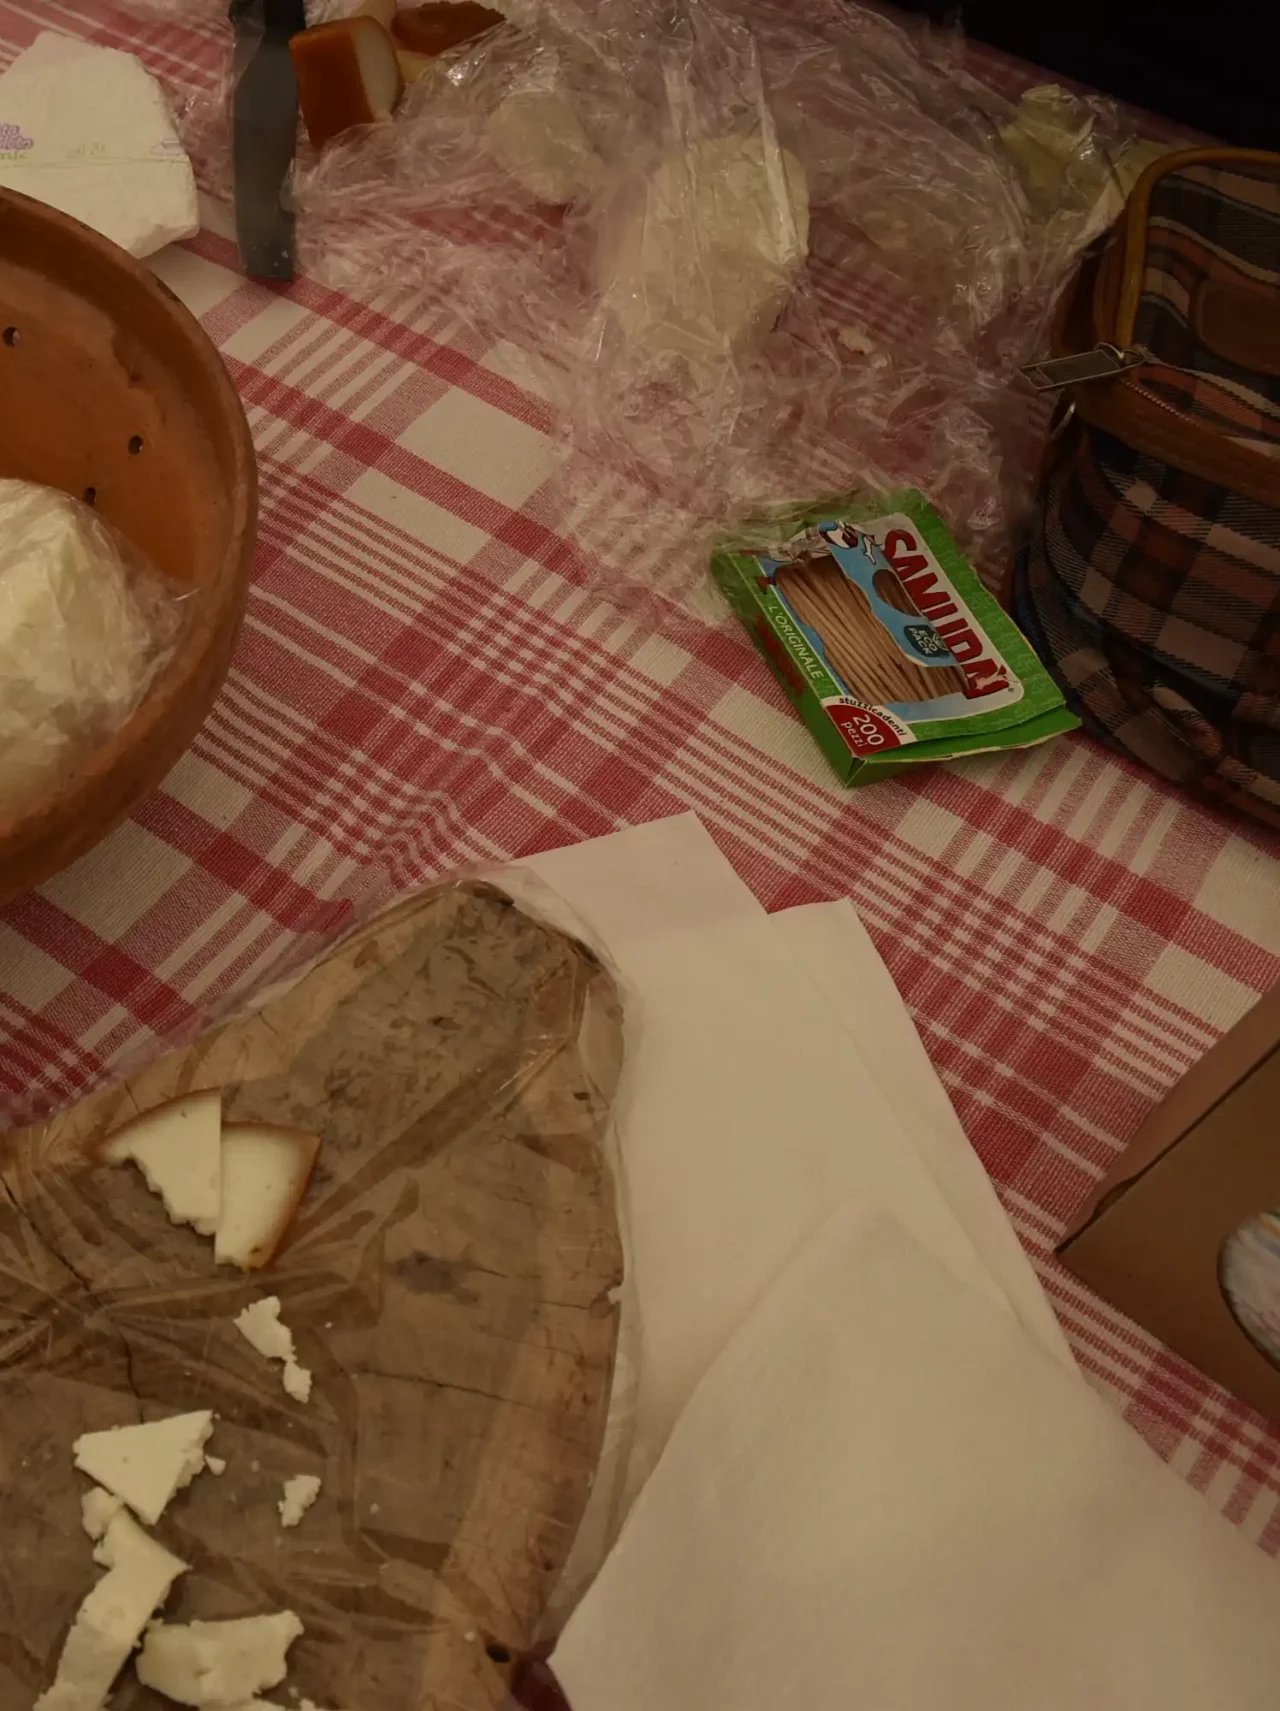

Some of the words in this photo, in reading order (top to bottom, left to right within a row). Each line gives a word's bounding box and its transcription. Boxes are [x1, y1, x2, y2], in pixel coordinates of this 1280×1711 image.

[767, 605, 823, 680] L'ORIGINALE
[909, 627, 933, 656] PACK
[918, 629, 938, 654] ECO
[838, 696, 908, 737] stuzzicadenti
[852, 713, 885, 747] 200
[841, 720, 866, 748] pezzi
